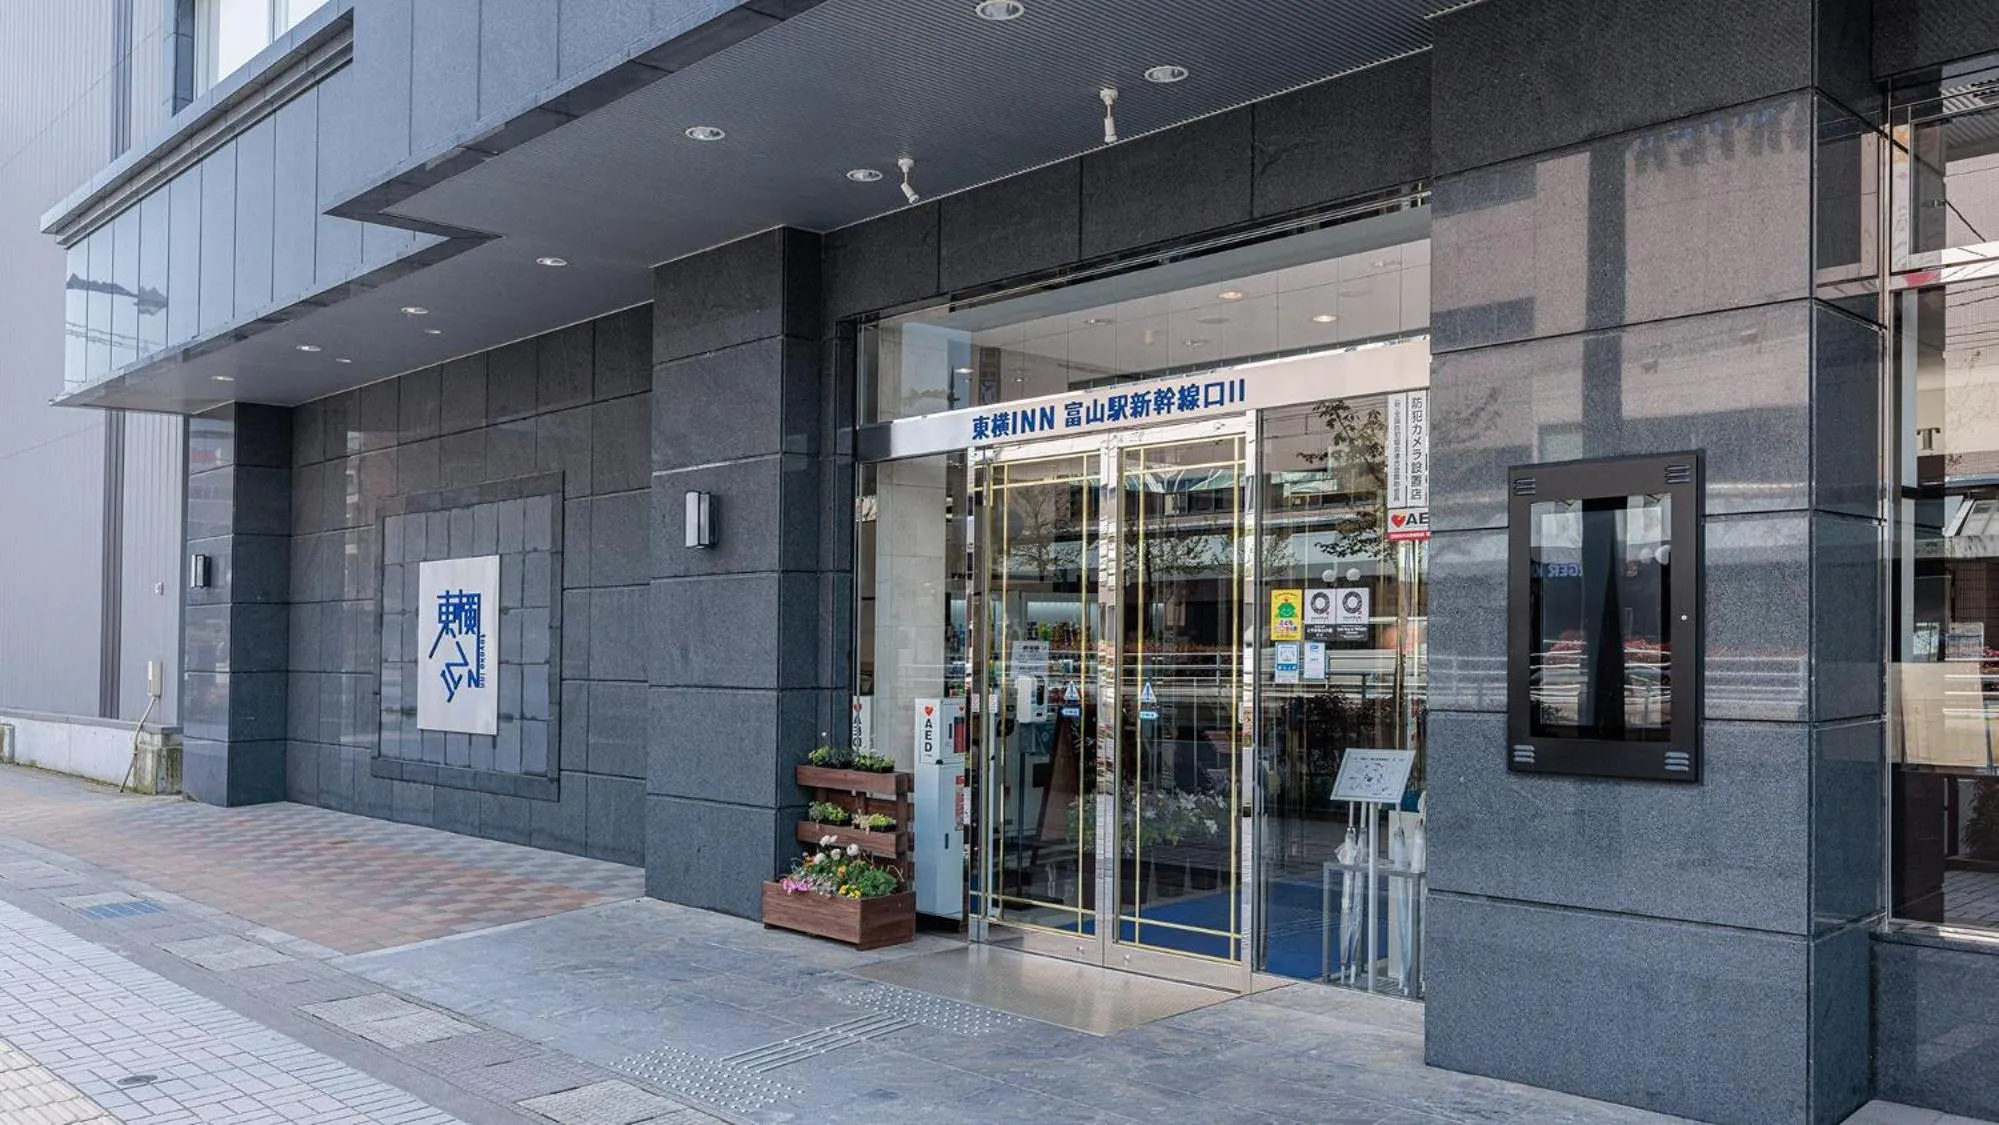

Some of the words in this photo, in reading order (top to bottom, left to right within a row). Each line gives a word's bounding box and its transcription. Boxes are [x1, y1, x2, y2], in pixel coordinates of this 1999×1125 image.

[972, 405, 1055, 440] 東横INN
[1411, 397, 1423, 500] 防犯カメラ設置店
[924, 718, 933, 752] AED
